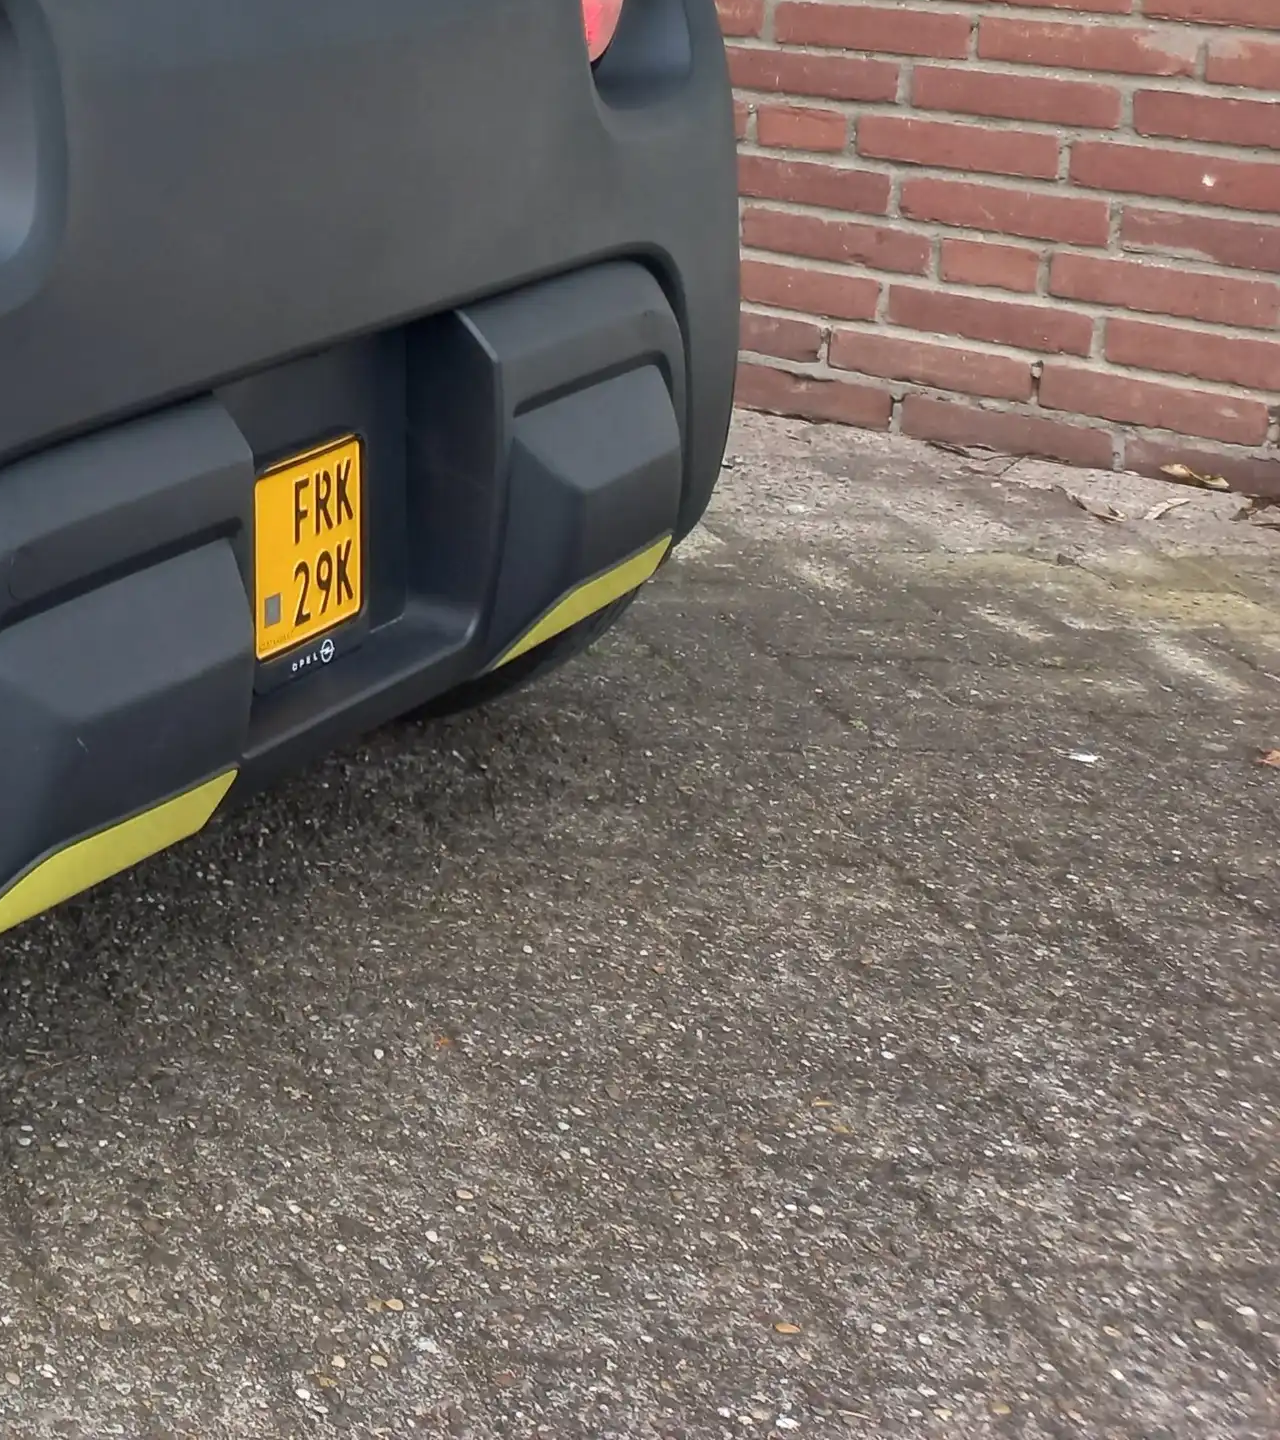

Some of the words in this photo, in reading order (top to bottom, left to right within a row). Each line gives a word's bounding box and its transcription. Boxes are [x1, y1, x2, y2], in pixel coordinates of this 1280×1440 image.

[293, 456, 354, 545] FRK
[292, 539, 354, 628] 29K
[292, 651, 319, 672] OPEL
